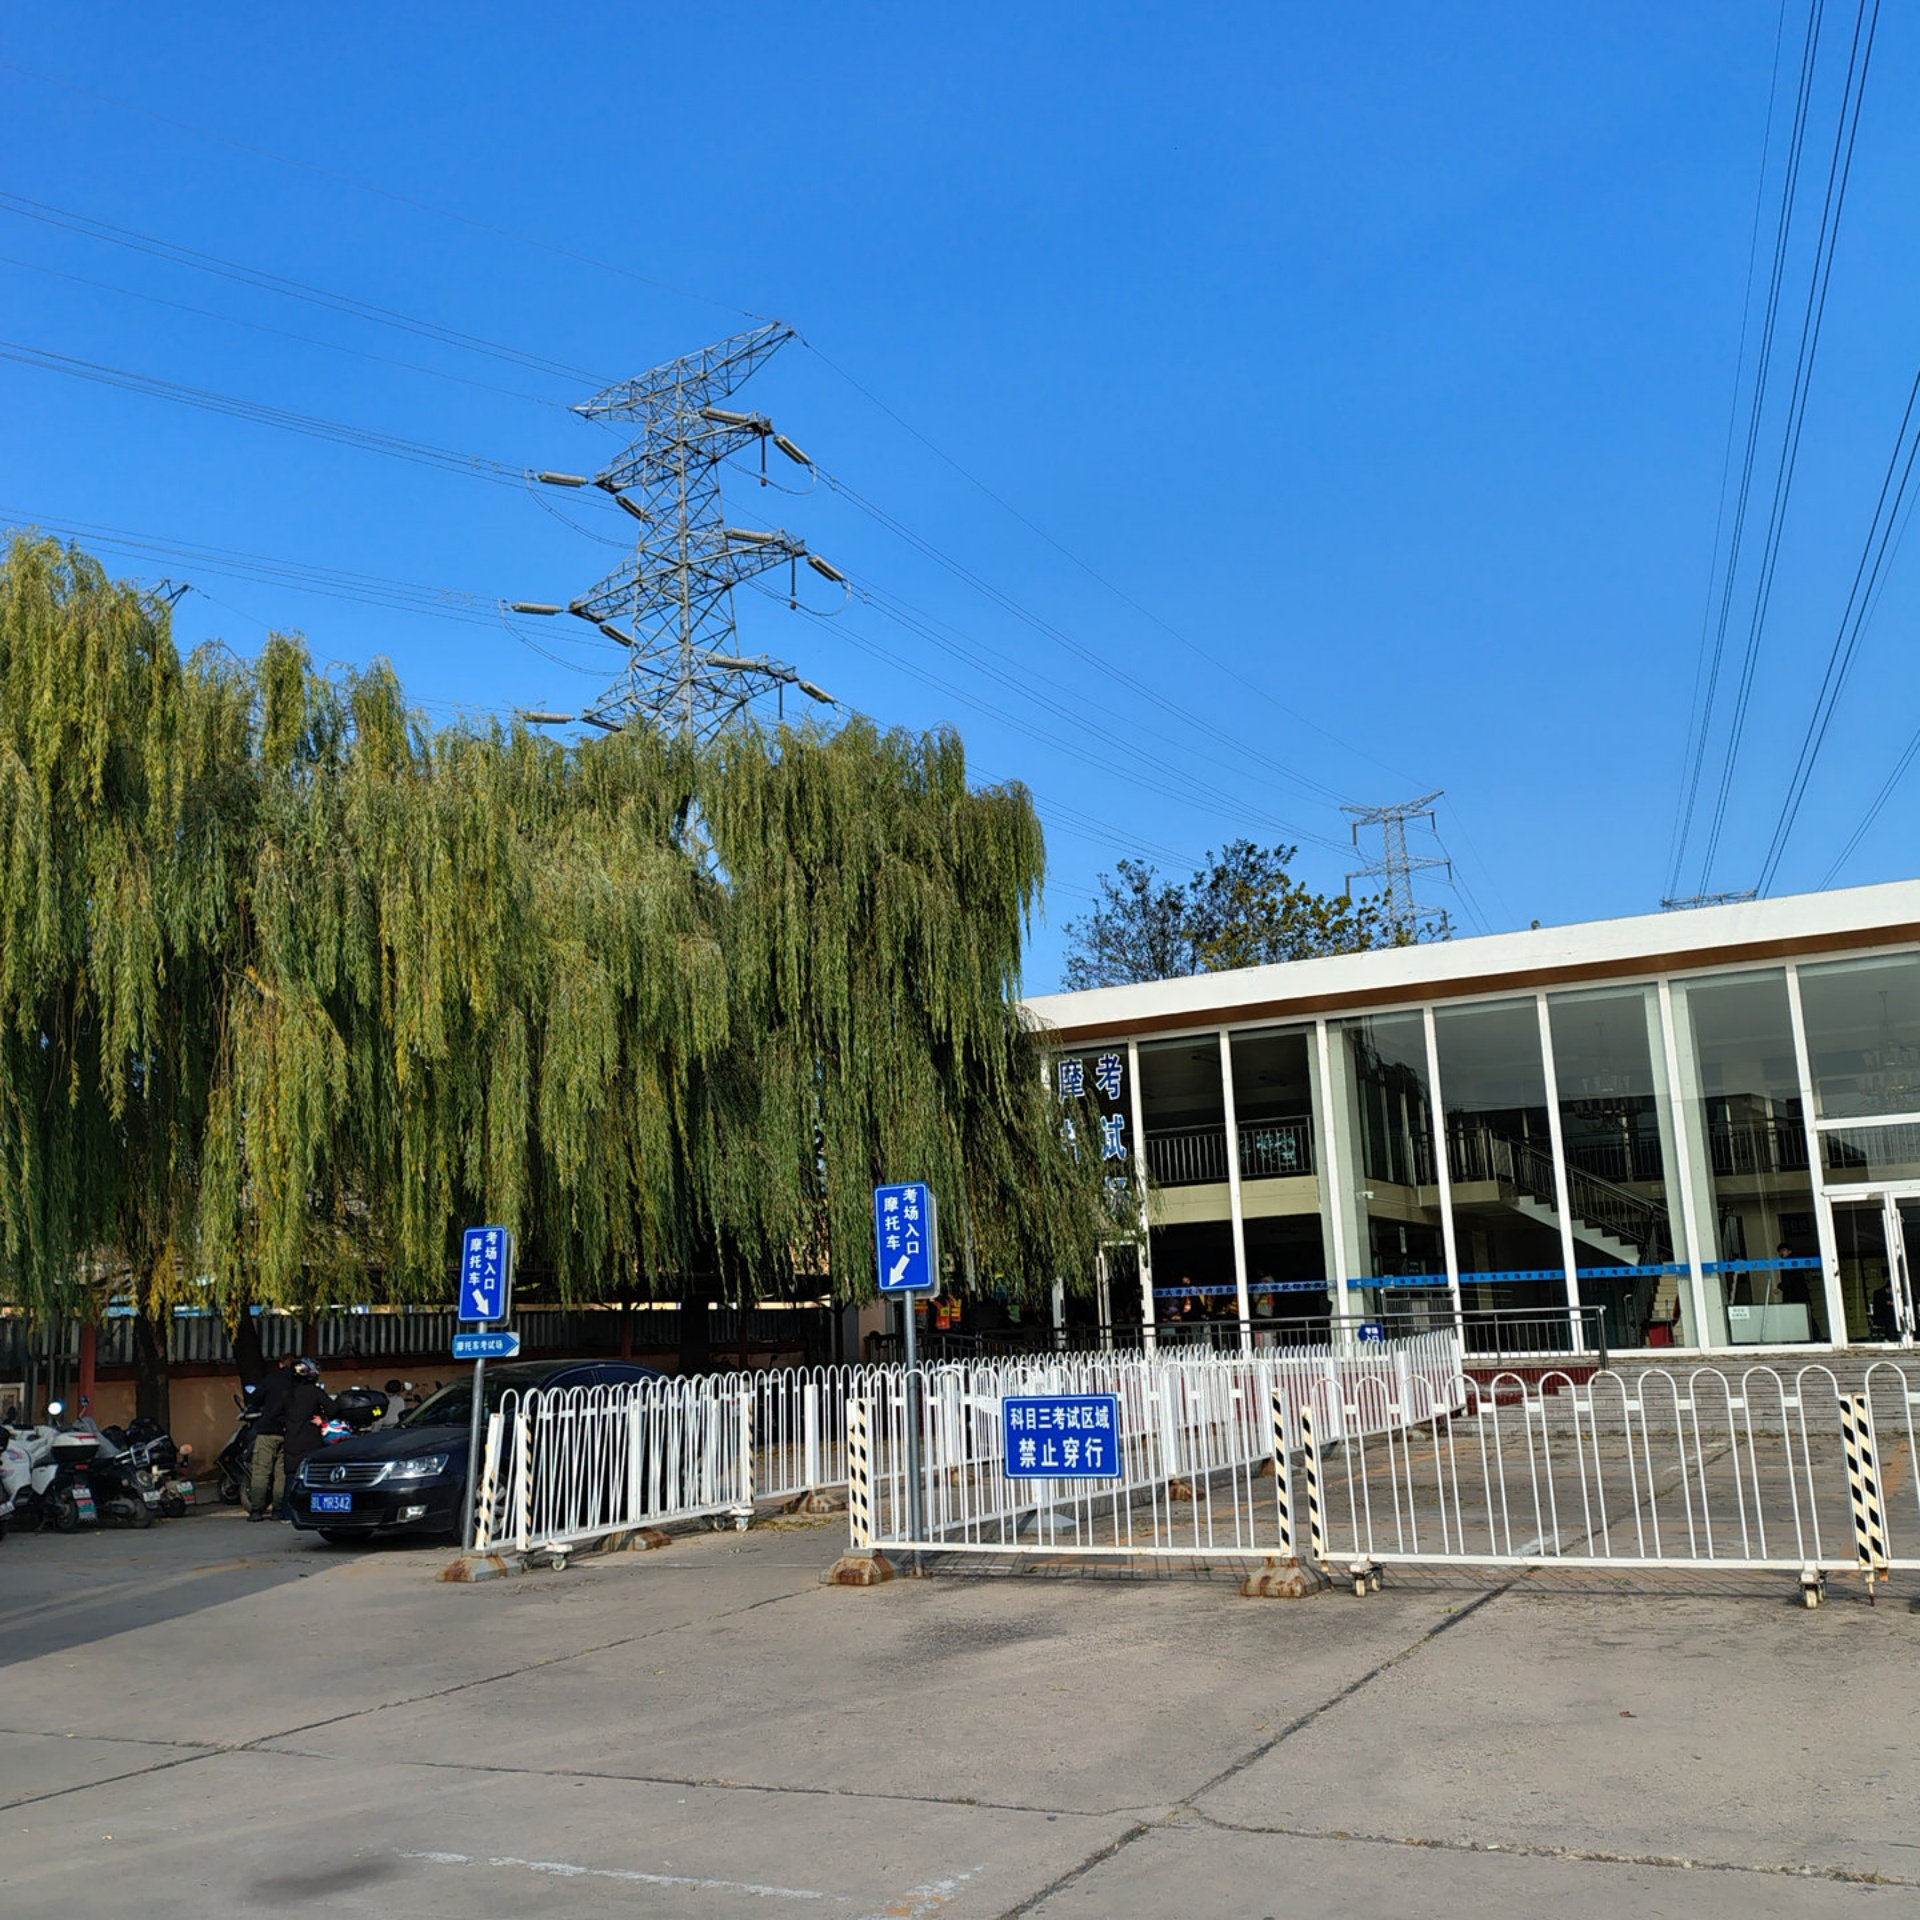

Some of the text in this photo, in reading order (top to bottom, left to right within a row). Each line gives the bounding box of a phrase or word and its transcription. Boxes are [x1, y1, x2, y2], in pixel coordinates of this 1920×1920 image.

[884, 1196, 901, 1251] 摩托车
[903, 1187, 920, 1255] 考场入口
[468, 1237, 483, 1286] 摩托车
[484, 1231, 498, 1291] 考场入口
[456, 1339, 504, 1352] 摩托车考试场
[1010, 1405, 1110, 1430] 科目三考试区域
[1019, 1436, 1103, 1469] 禁止穿行
